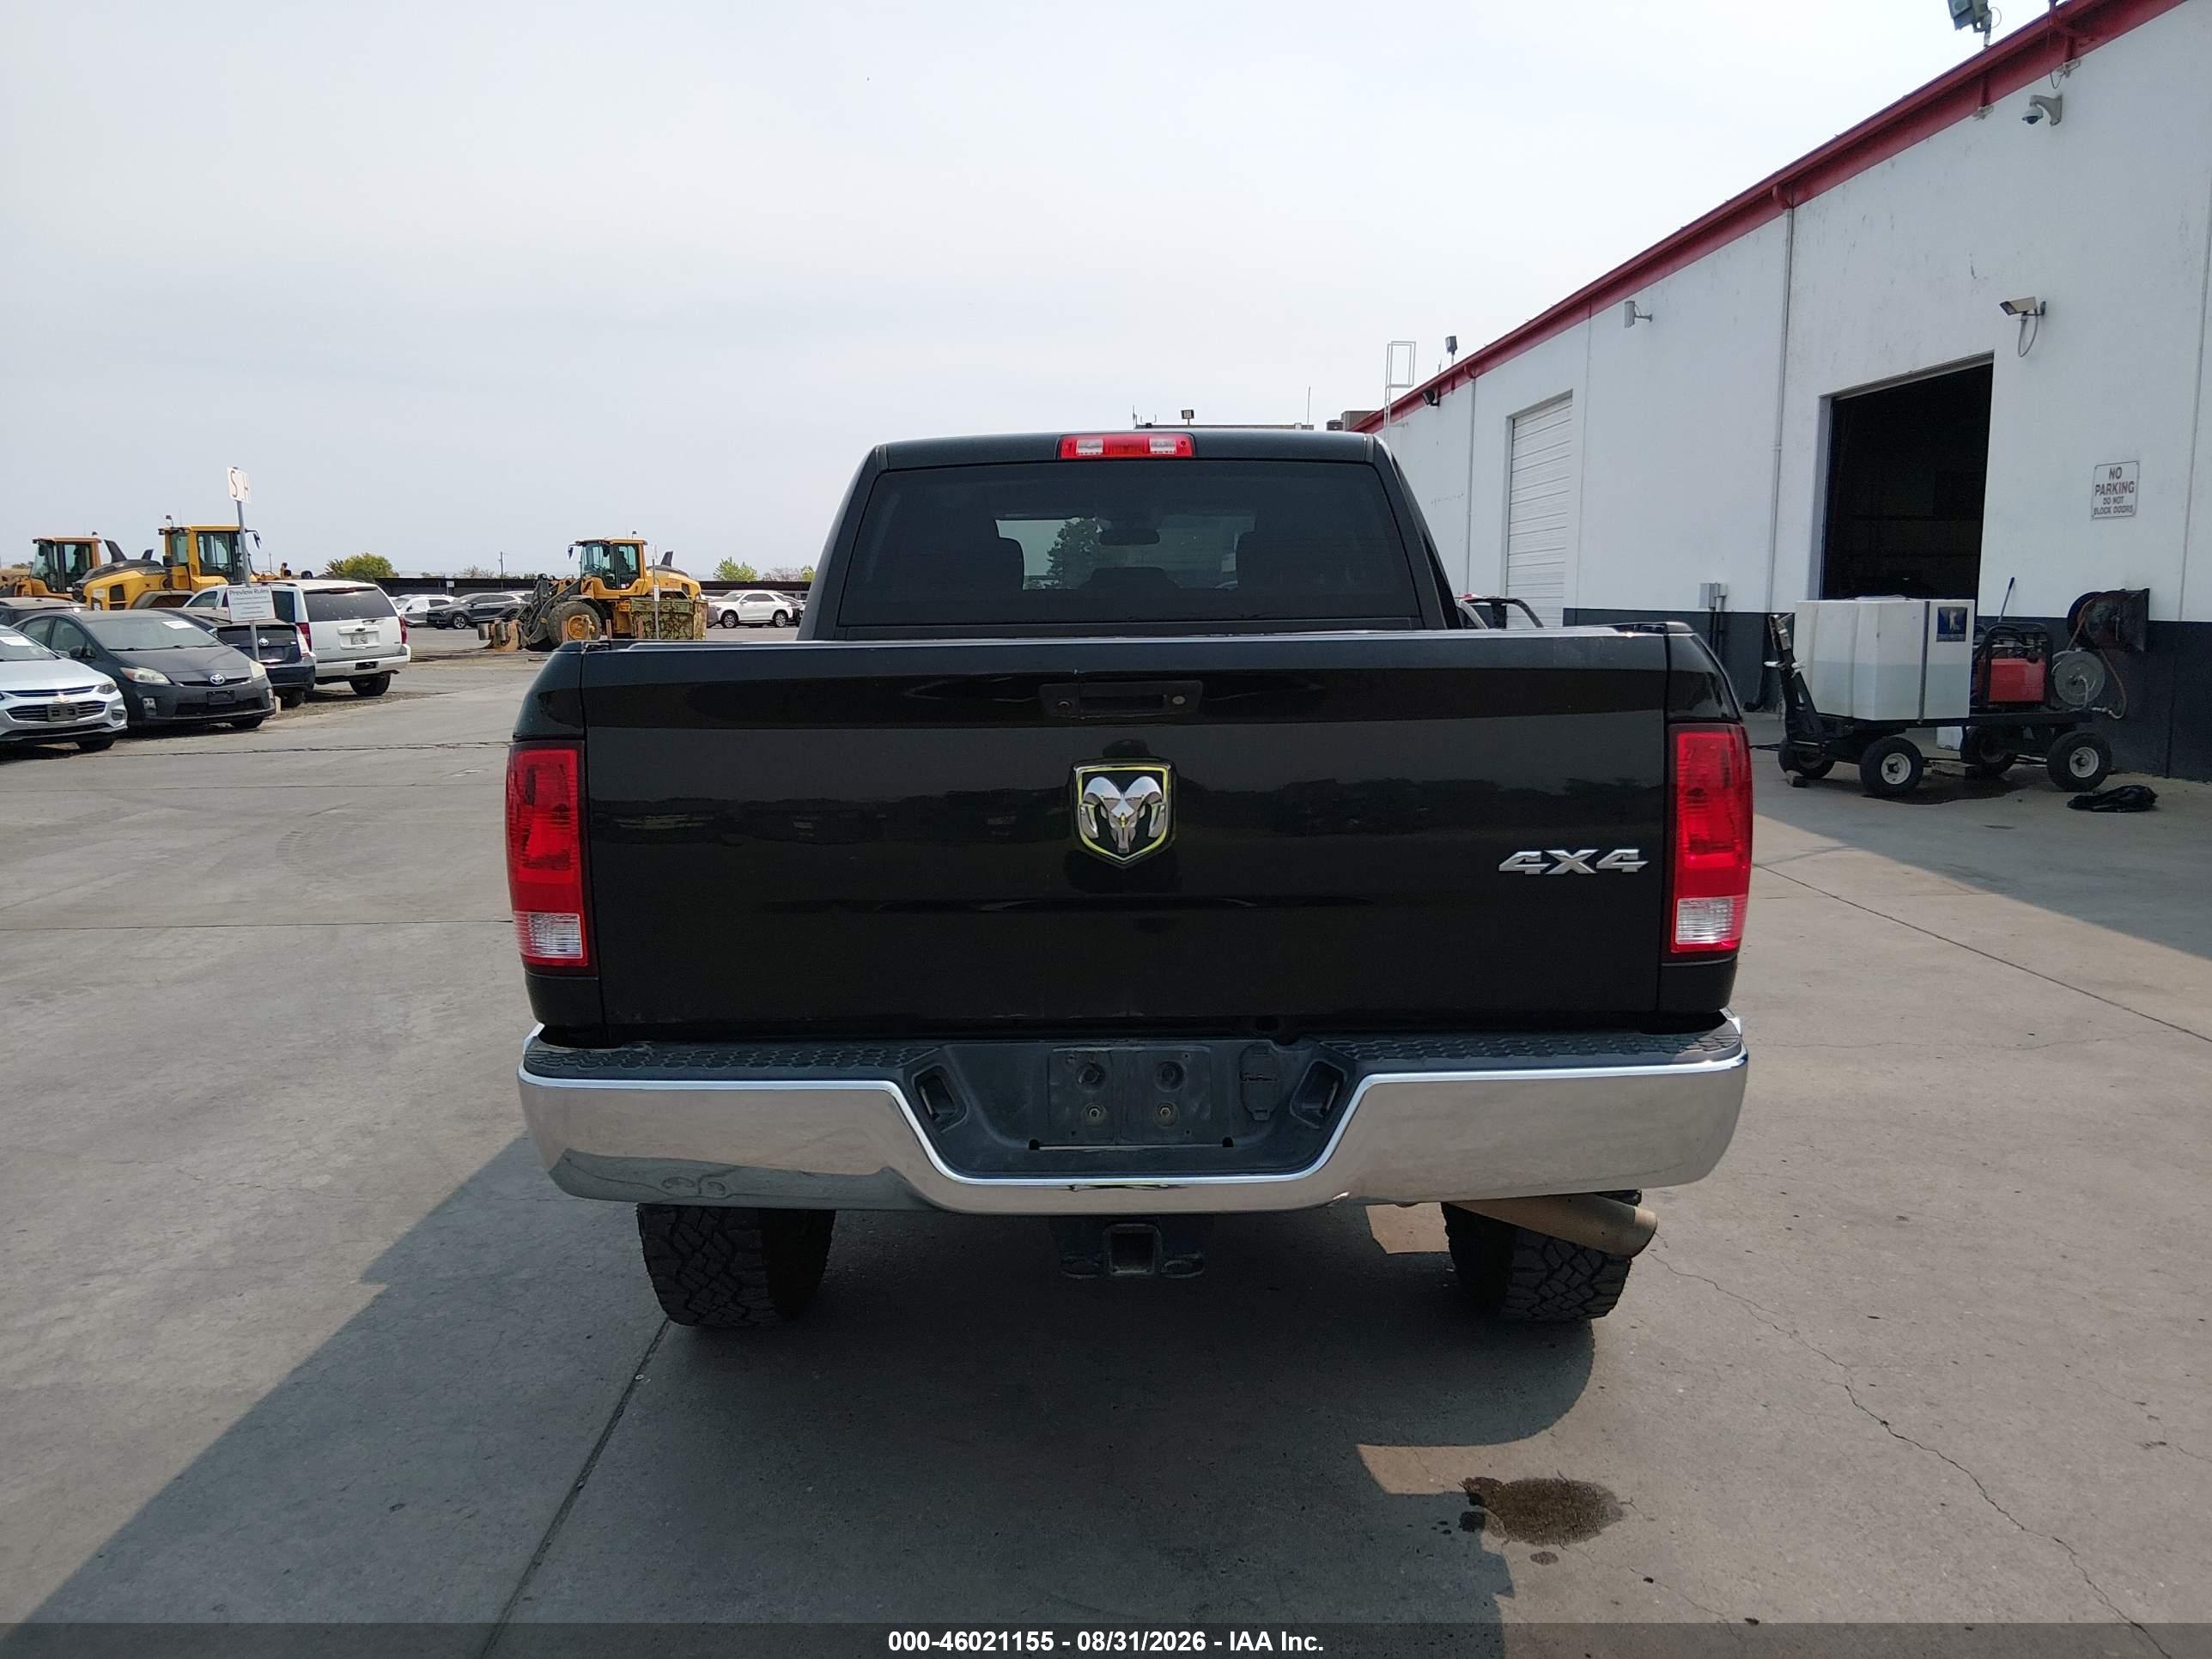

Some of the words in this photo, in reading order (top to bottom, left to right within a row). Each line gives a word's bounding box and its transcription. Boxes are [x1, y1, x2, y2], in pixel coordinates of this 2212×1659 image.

[2109, 466, 2123, 480] NO
[2095, 481, 2135, 495] PARKING
[2112, 495, 2124, 504] NOT
[2094, 506, 2112, 515] BLOCK
[2113, 505, 2133, 514] DOORS
